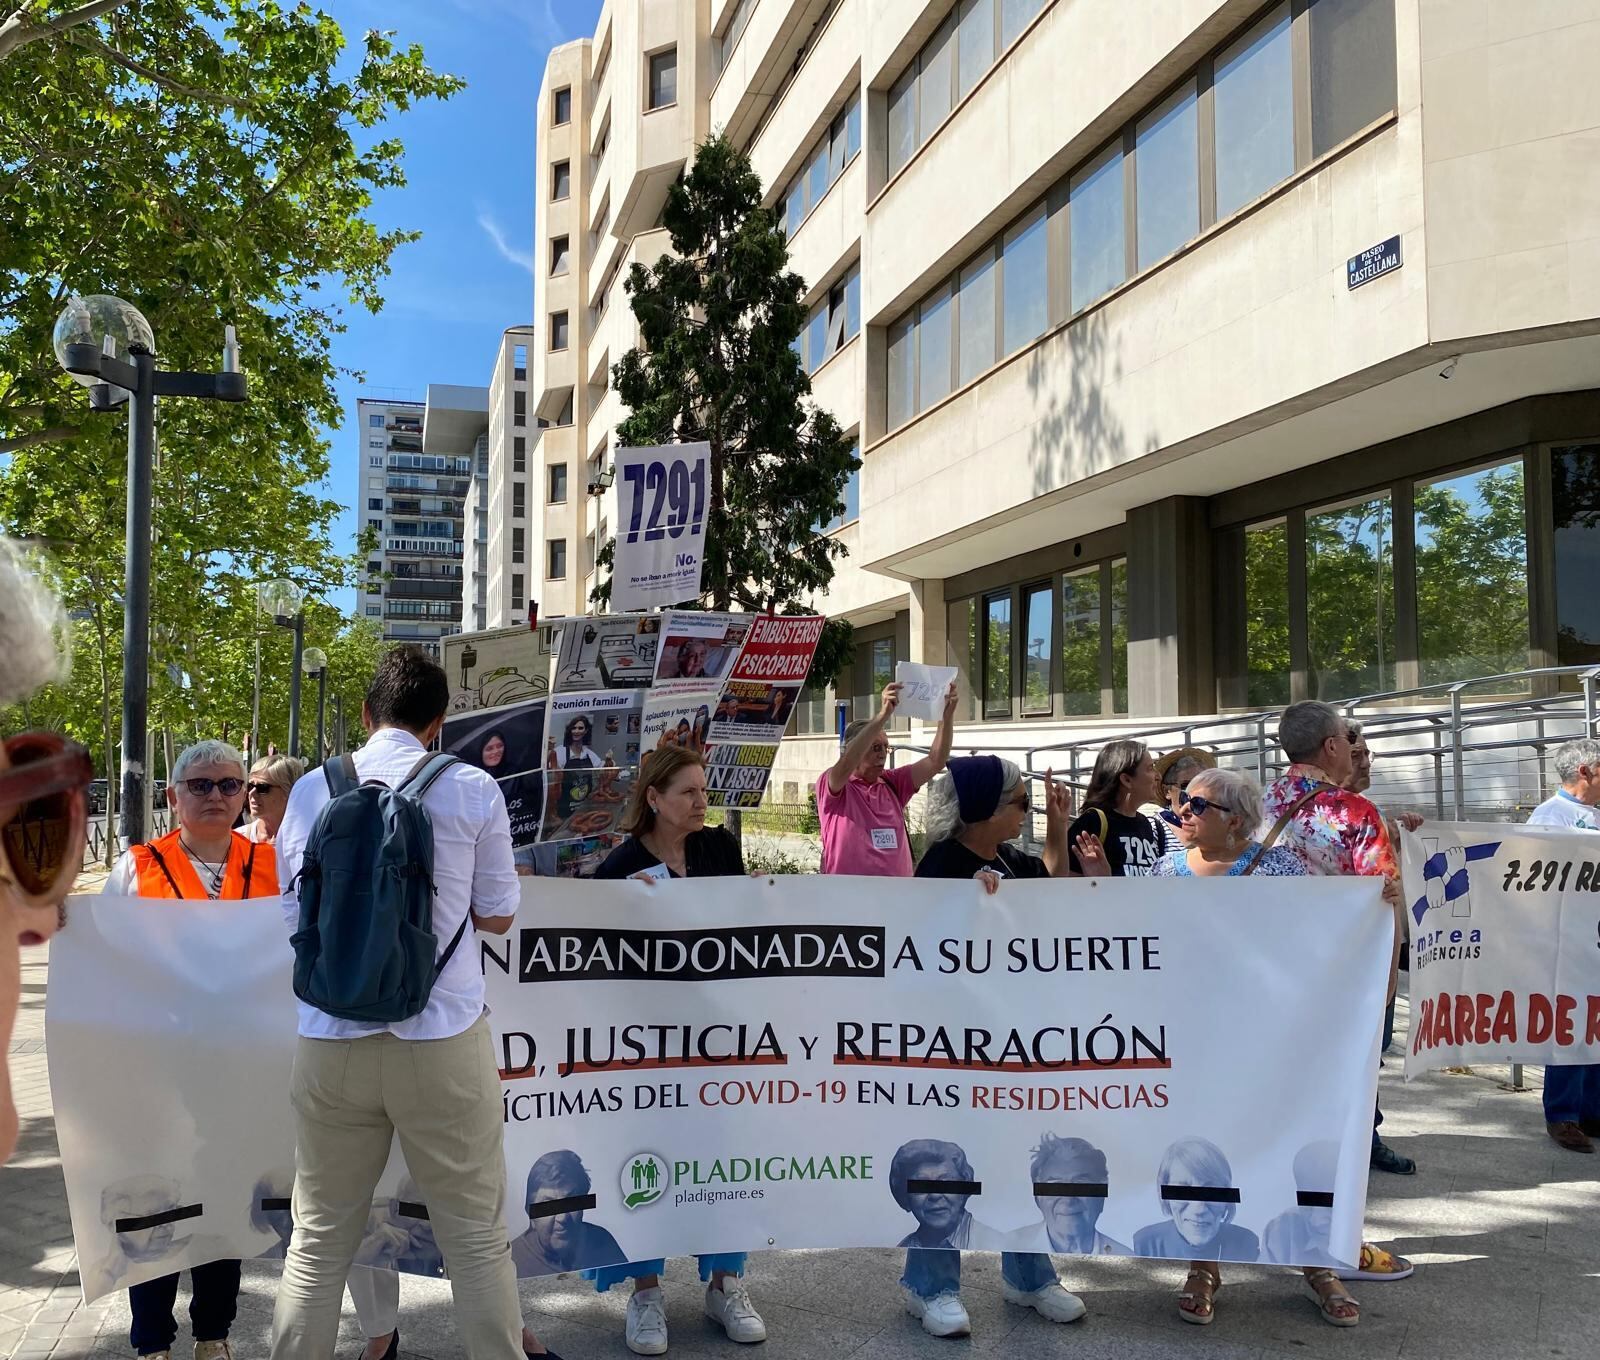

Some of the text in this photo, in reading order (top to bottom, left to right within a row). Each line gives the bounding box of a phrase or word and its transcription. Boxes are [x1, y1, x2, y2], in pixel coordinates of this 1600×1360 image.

[1361, 244, 1385, 261] PASEO
[1350, 253, 1398, 285] CASTELLANA
[623, 458, 705, 544] 7291
[675, 553, 697, 567] No.
[750, 619, 822, 644] EMBUSTEROS
[736, 649, 810, 676] PSICÓPATAS
[552, 696, 629, 710] Reunión familiar
[746, 690, 770, 699] SERIE
[671, 709, 676, 718] y
[726, 767, 765, 790] ASCO
[738, 791, 762, 806] PP
[874, 833, 896, 844] 7291
[1503, 860, 1573, 892] 7.291
[1417, 929, 1481, 953] marea
[524, 933, 881, 974] ABANDONADAS
[893, 936, 924, 971] A
[938, 938, 992, 974] SU
[1007, 936, 1161, 973] SUERTE
[1417, 946, 1481, 970] RESIDENCIAS
[1527, 993, 1577, 1046] DE
[560, 1022, 786, 1078] JUSTICIA
[836, 1014, 1167, 1068] REPARACIÓN
[634, 1083, 689, 1110] DEL
[699, 1079, 847, 1106] COVID-19
[858, 1080, 895, 1104] EN
[907, 1082, 961, 1108] LAS
[972, 1083, 1169, 1111] RESIDENCIAS
[674, 1155, 874, 1186] PLADIGMARE
[675, 1188, 764, 1207] pladigmare.es
